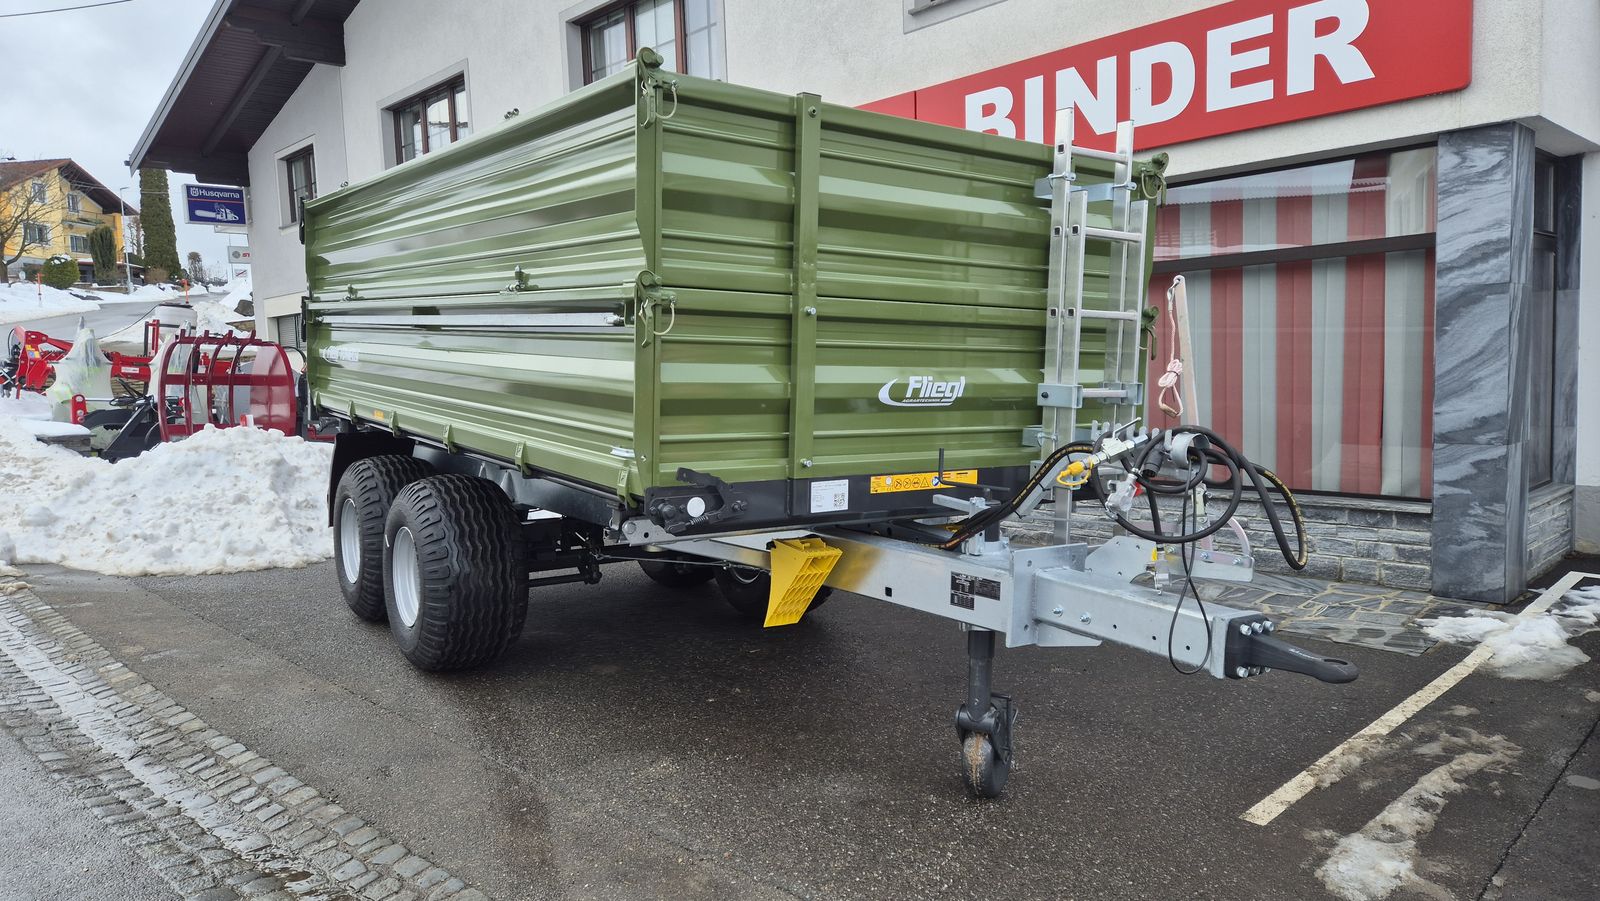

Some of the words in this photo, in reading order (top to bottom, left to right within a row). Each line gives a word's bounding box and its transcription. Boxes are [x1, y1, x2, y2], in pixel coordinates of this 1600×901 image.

[965, 0, 1375, 144] BINDER
[200, 189, 240, 198] Husqvarna
[906, 376, 966, 402] Fliegl
